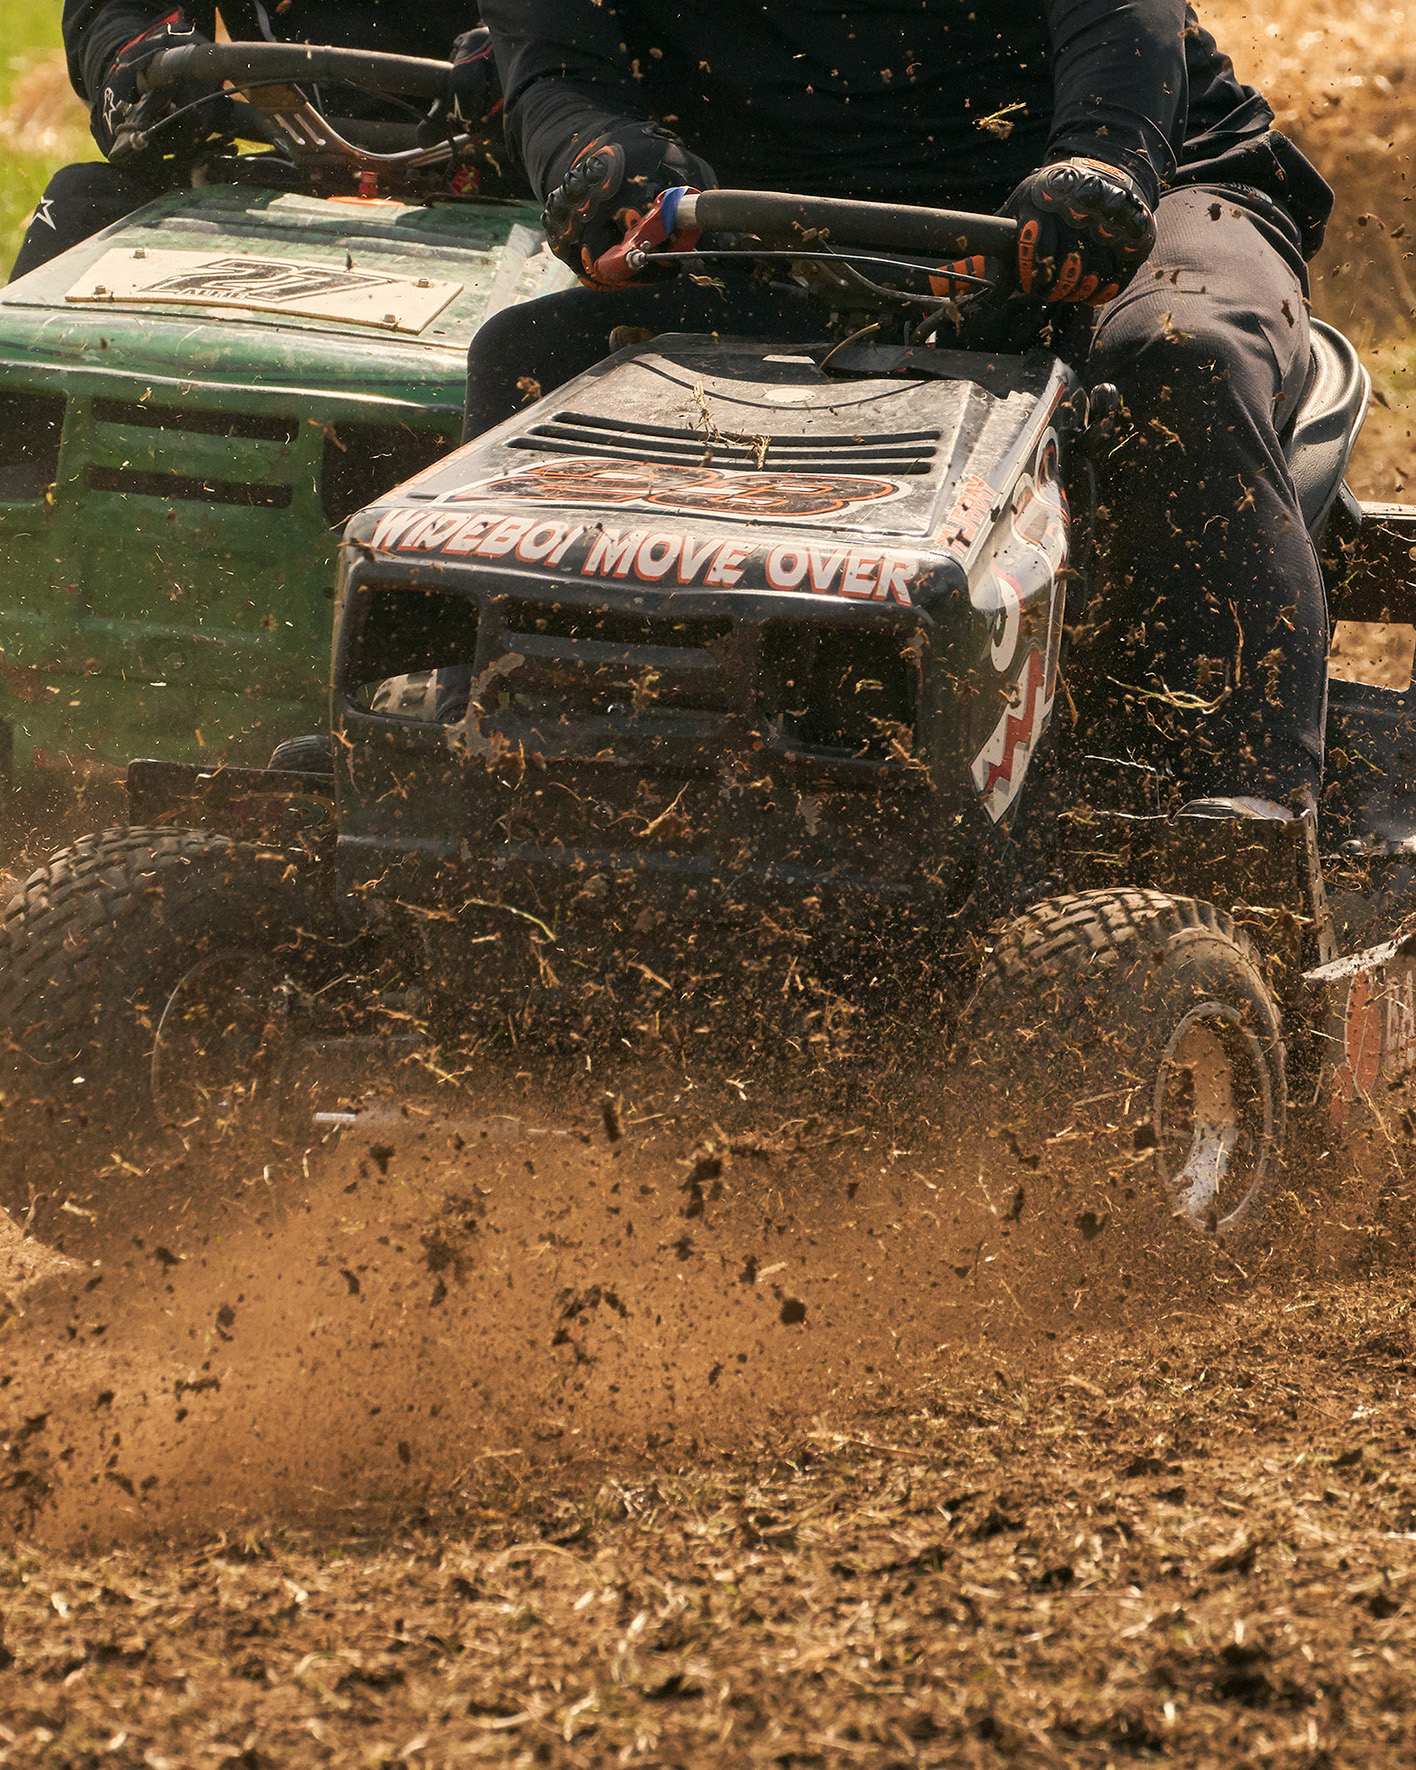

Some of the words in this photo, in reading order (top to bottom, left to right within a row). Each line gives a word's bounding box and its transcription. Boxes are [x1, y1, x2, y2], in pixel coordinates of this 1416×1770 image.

[138, 258, 397, 302] 27
[581, 528, 760, 588] MOVE
[766, 543, 920, 607] OVER
